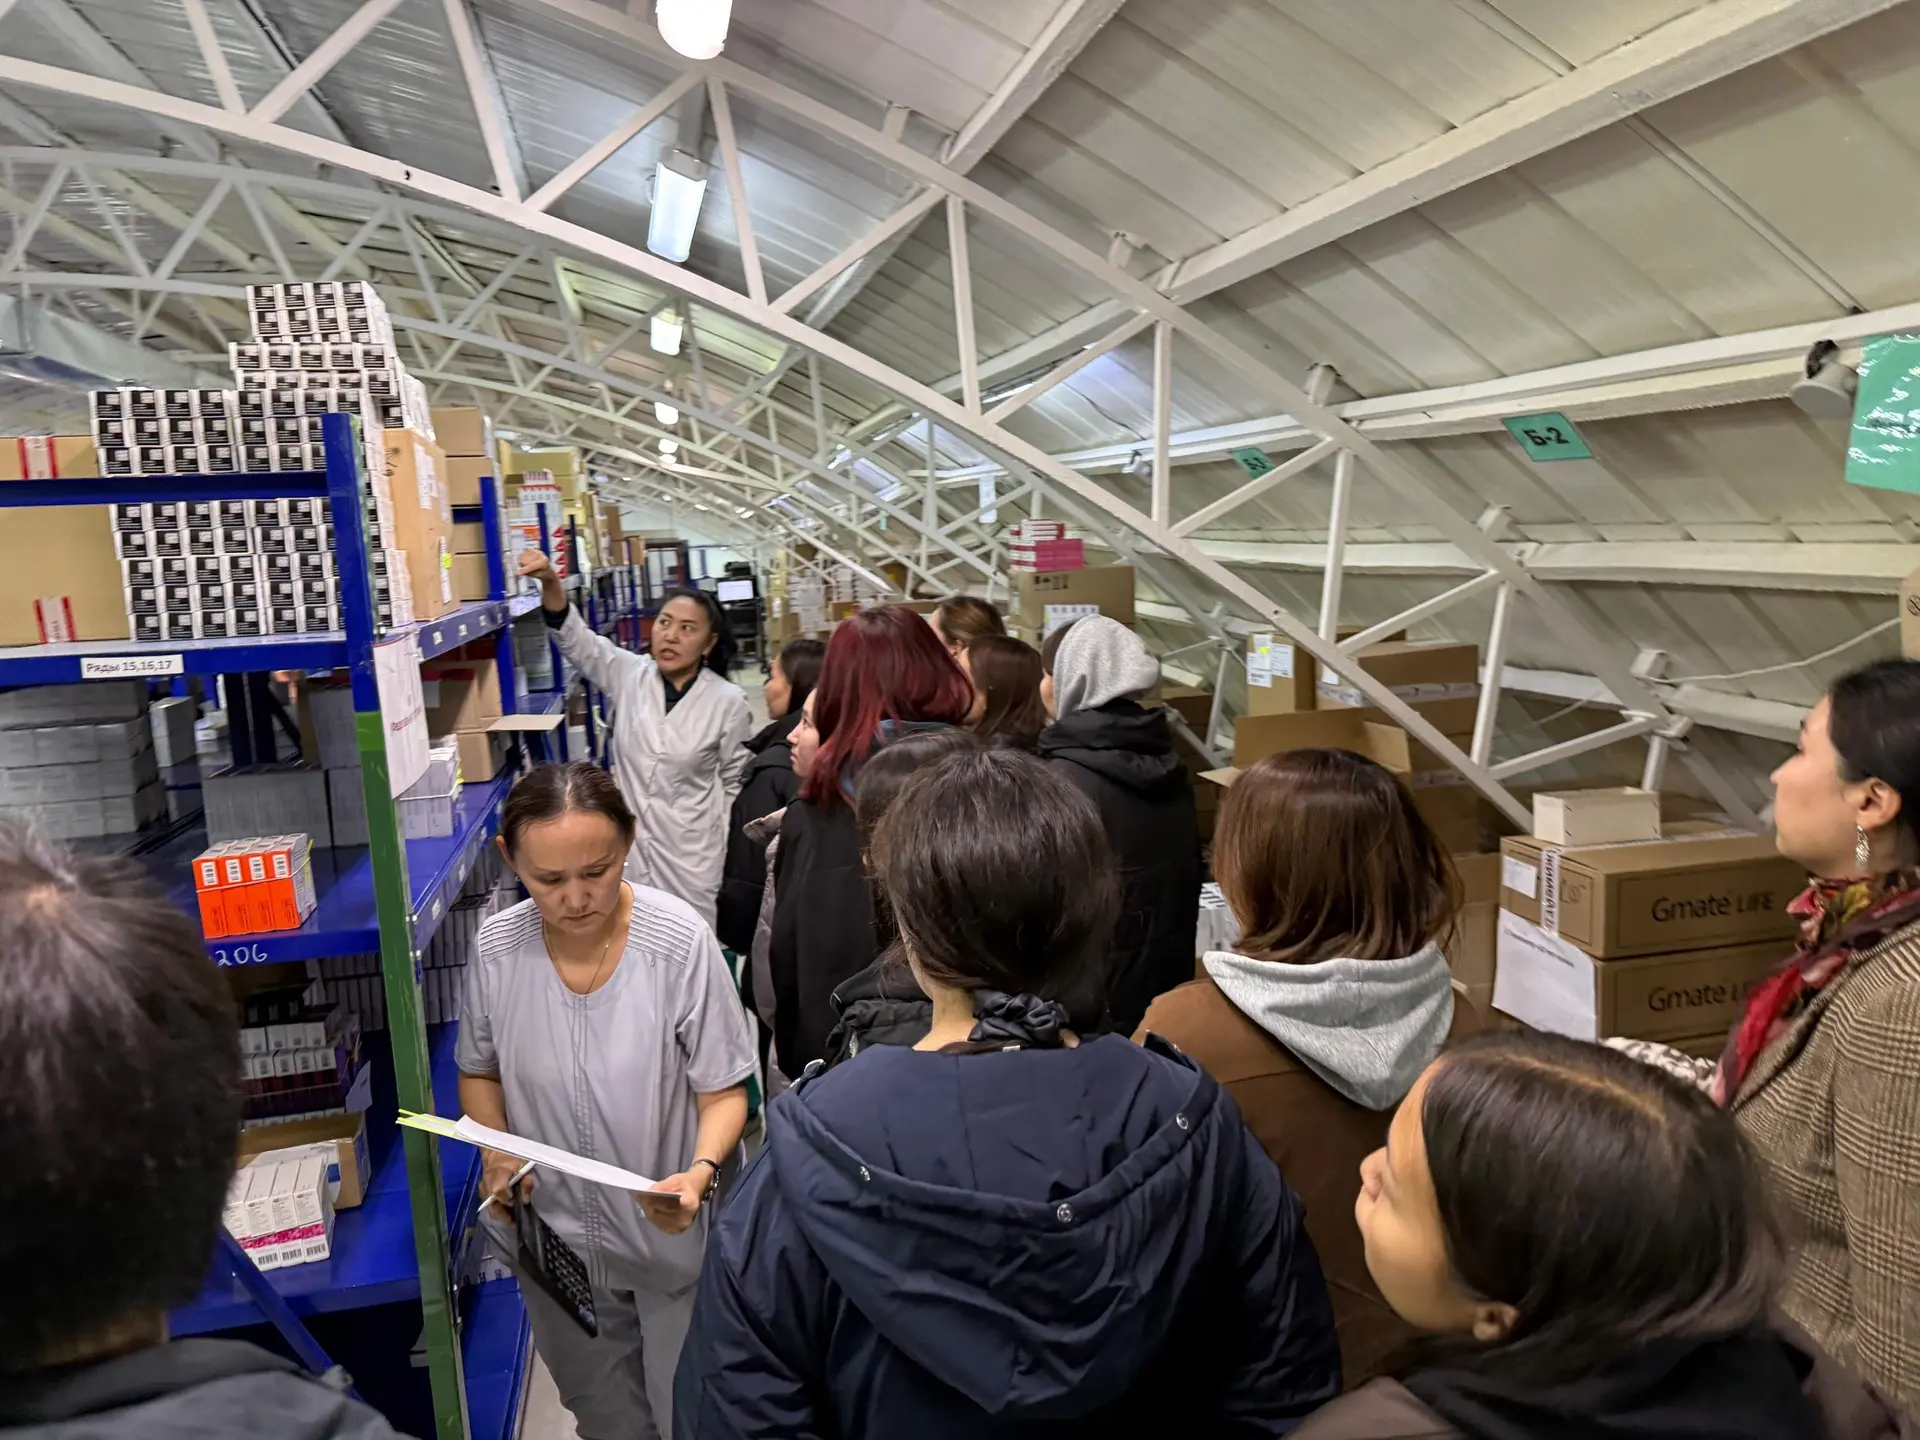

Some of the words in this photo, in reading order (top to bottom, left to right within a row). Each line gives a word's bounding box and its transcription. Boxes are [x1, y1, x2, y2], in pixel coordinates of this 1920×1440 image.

[86, 663, 120, 674] Ряды
[122, 660, 172, 672] 15,16,17
[1652, 894, 1732, 922] Gmate
[1736, 892, 1774, 914] LIFE
[215, 944, 268, 966] 206
[1648, 985, 1727, 1012] Gmate
